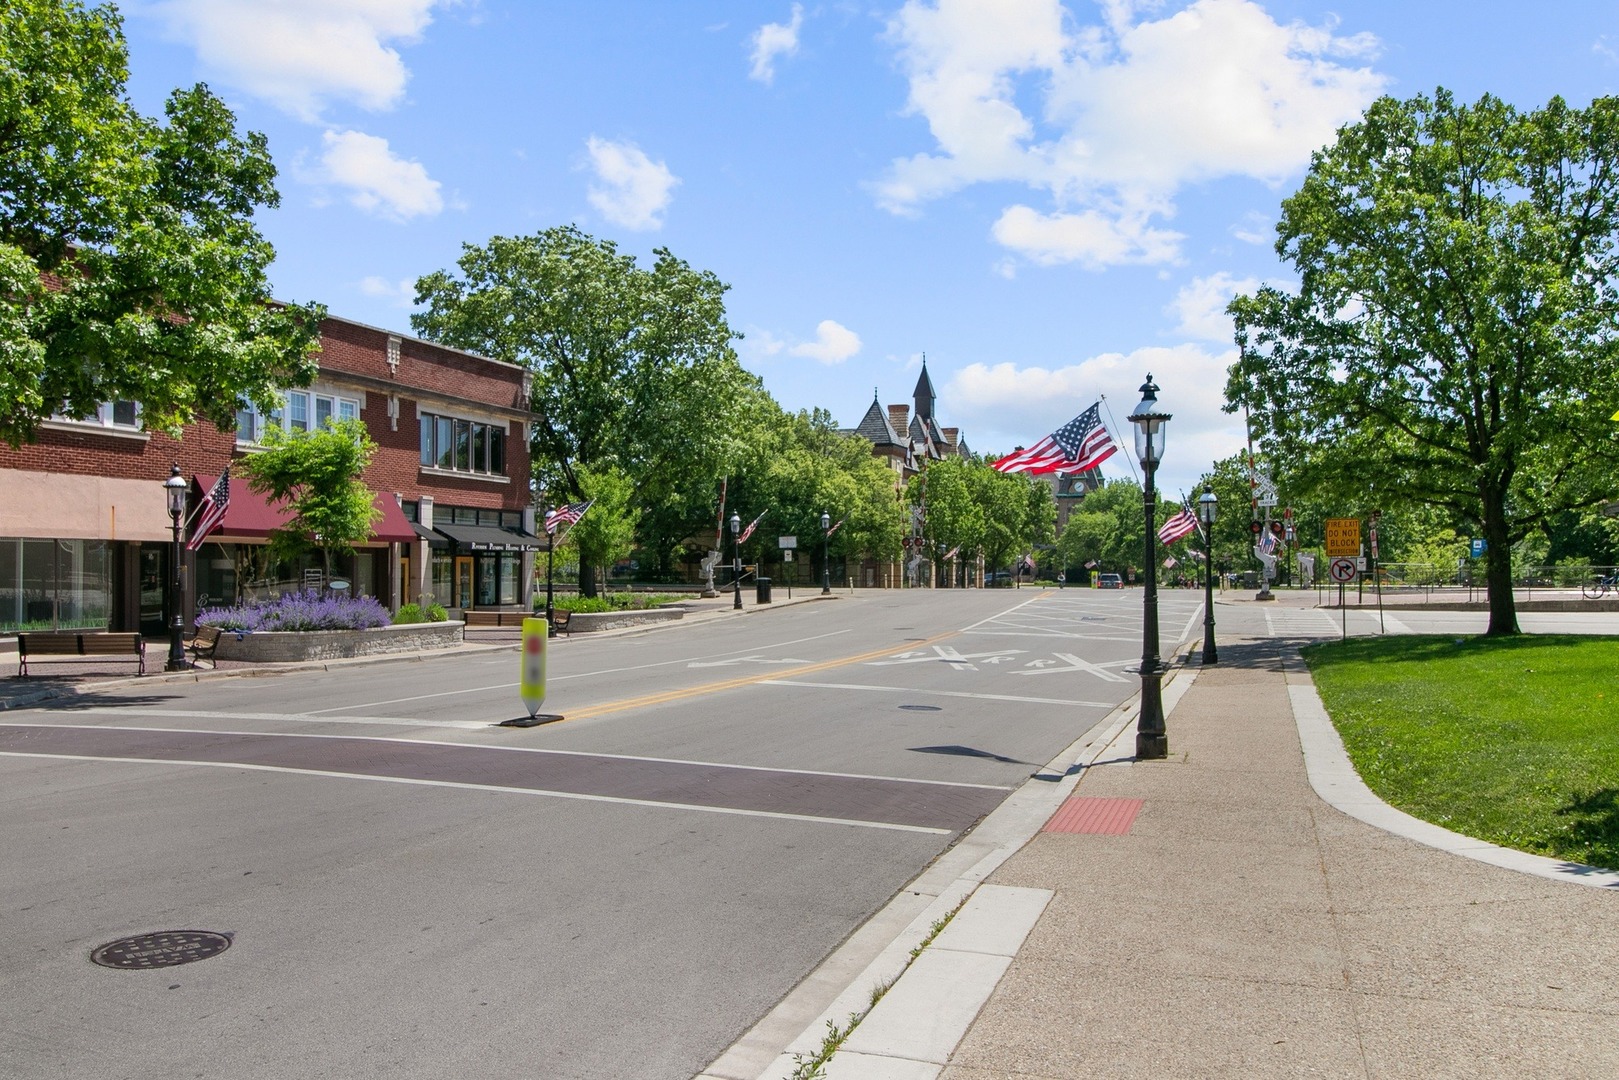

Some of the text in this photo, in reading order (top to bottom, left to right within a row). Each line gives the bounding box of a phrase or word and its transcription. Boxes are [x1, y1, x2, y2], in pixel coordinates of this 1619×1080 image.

[1327, 520, 1359, 528] FIRE EXIT
[1328, 529, 1358, 538] DO NOT
[1330, 539, 1356, 547] BLOCK
